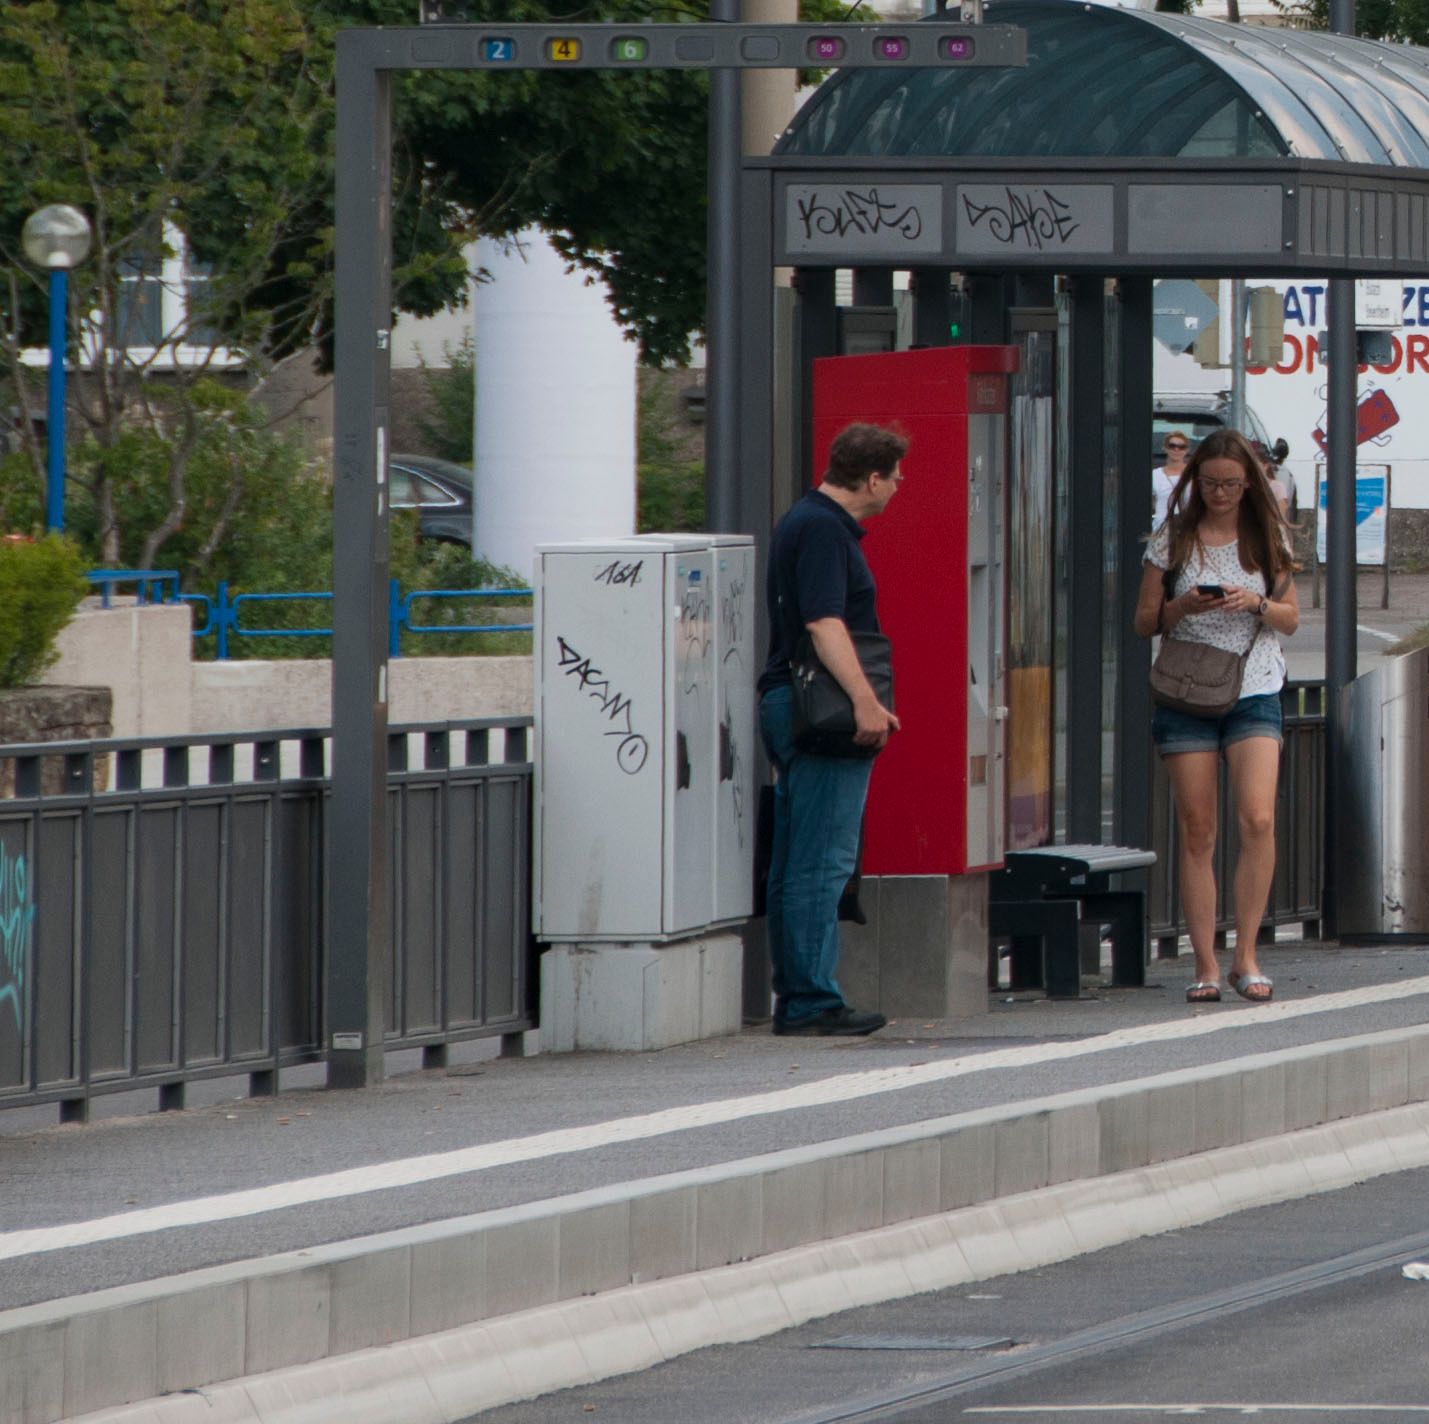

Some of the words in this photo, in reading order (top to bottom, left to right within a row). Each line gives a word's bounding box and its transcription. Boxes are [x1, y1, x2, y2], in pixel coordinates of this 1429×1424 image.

[492, 40, 505, 59] 2
[557, 40, 571, 58] 4
[624, 40, 638, 59] 6
[820, 43, 833, 53] 50
[886, 43, 898, 53] 55
[951, 43, 964, 53] 62
